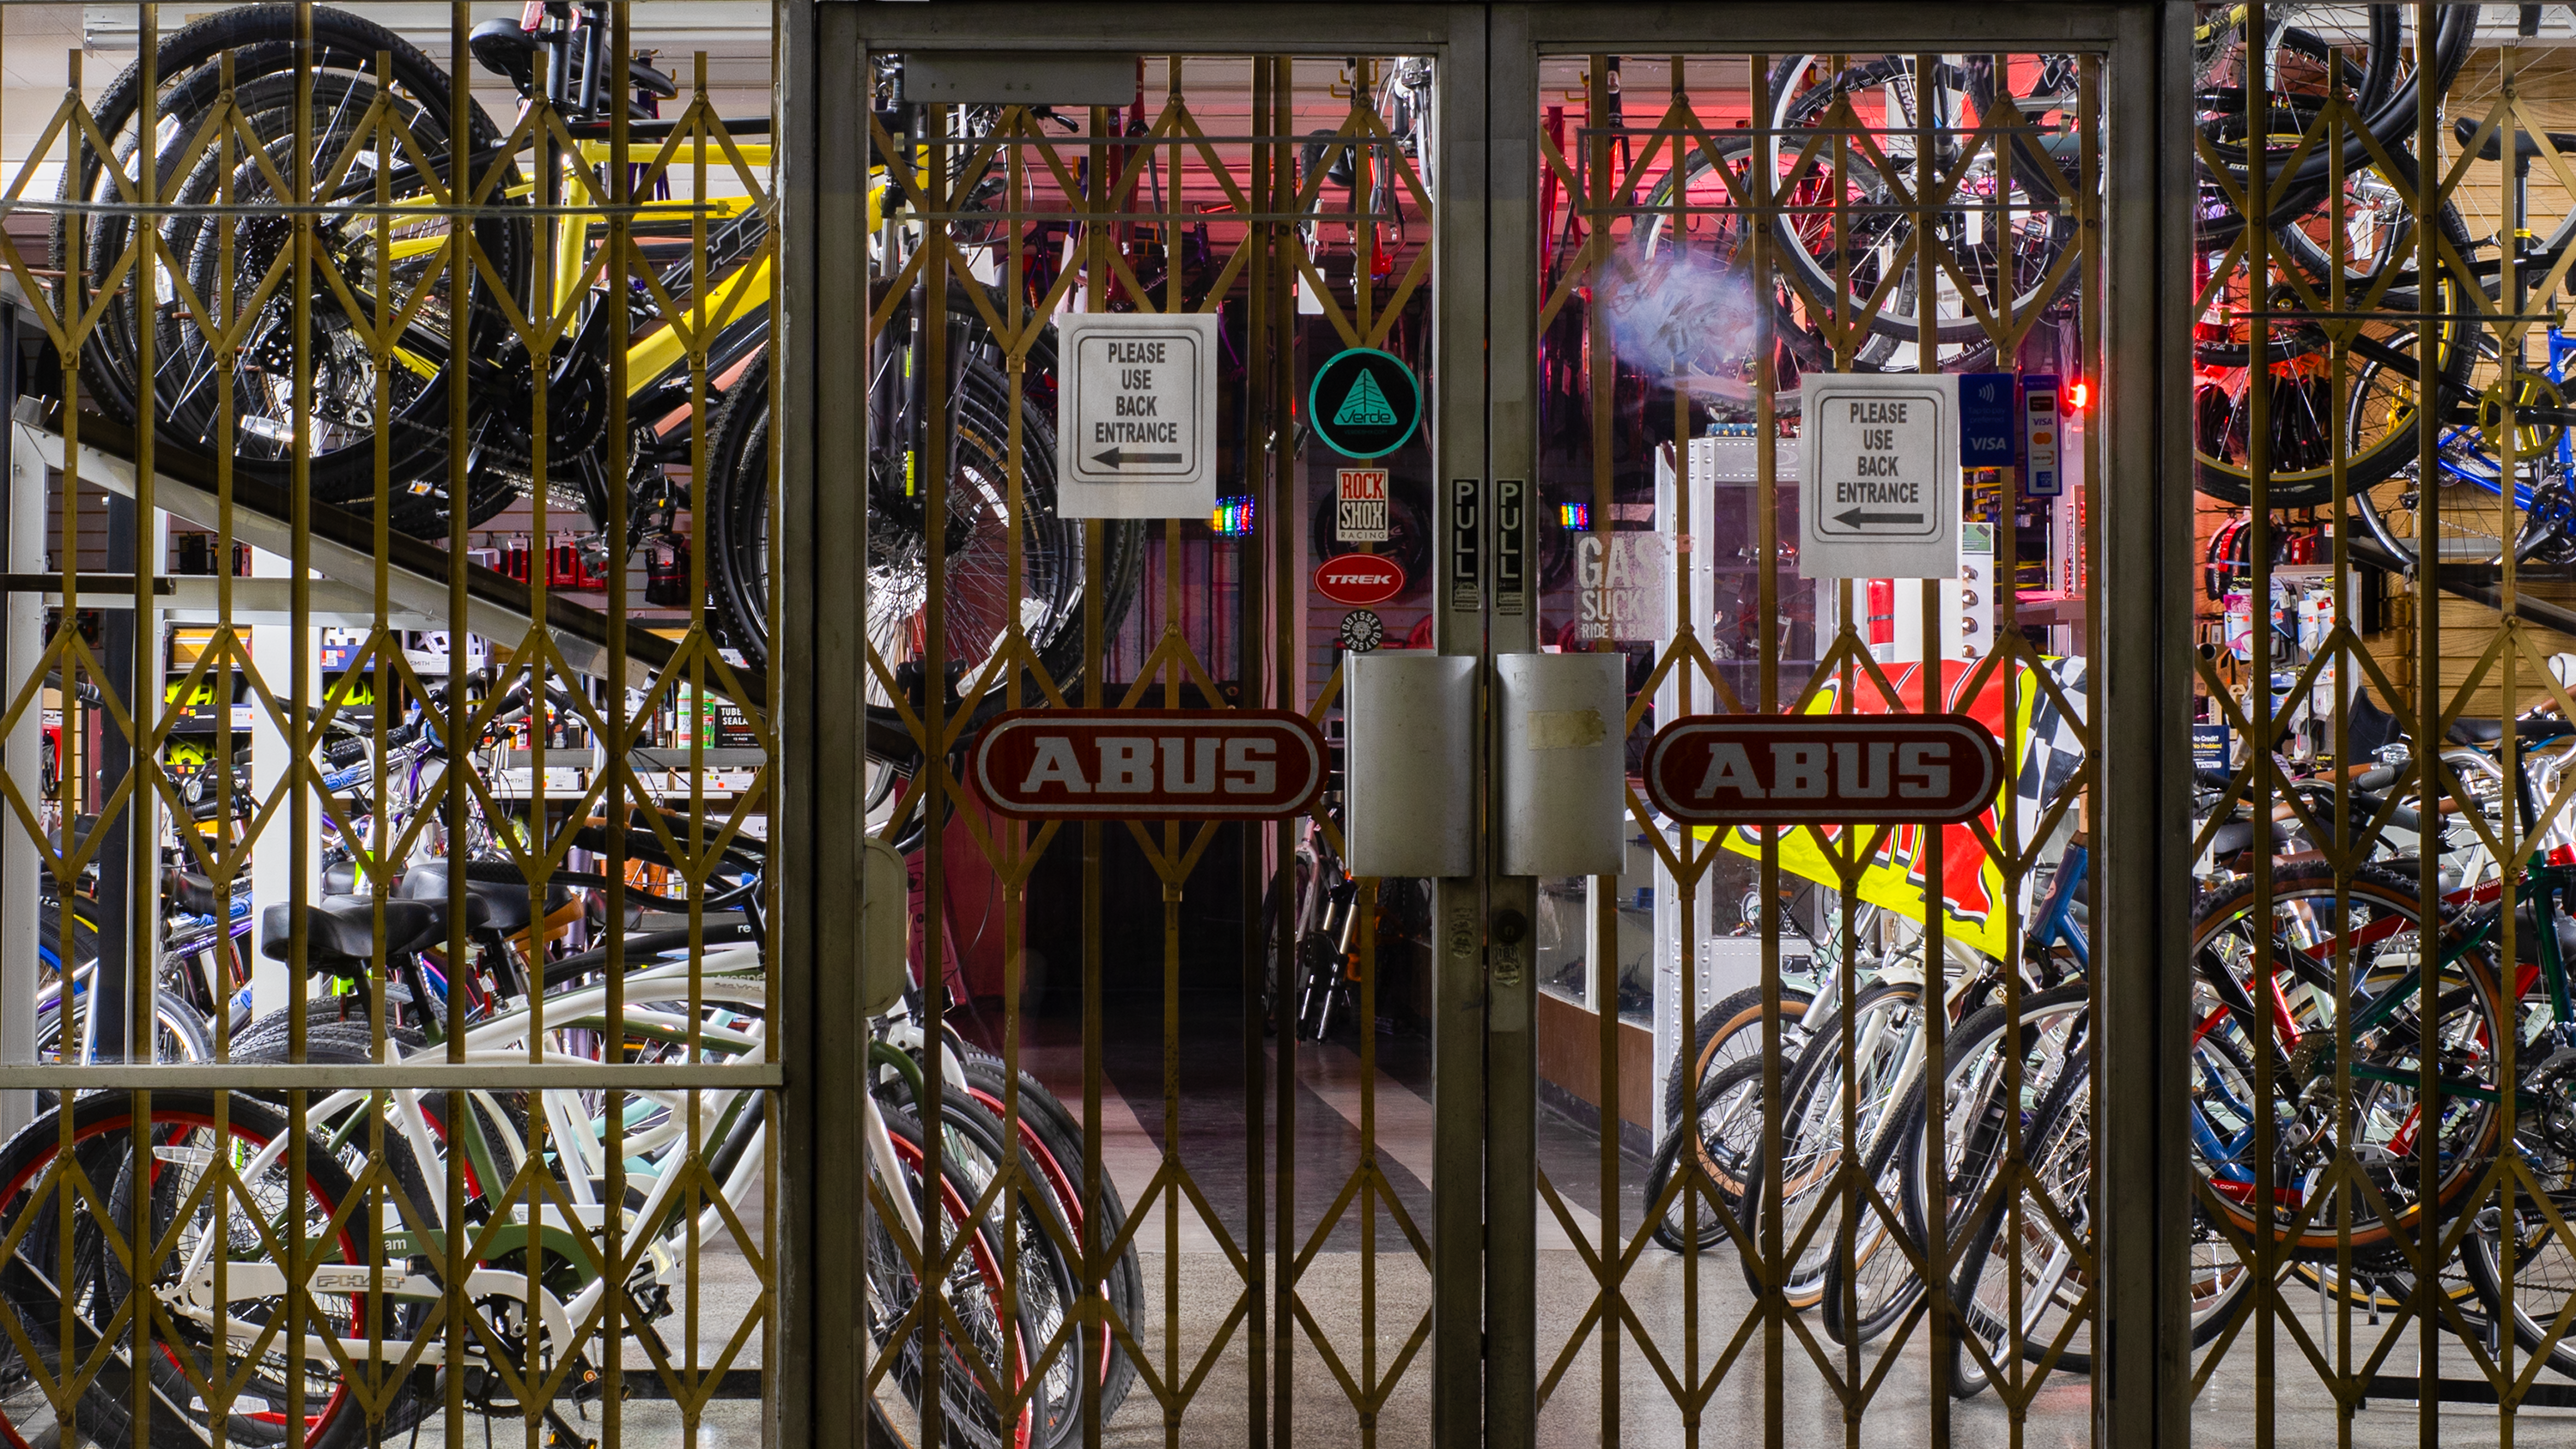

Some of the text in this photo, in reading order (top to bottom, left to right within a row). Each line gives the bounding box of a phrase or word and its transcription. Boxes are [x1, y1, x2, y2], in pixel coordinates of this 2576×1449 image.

[1108, 343, 1165, 363] PLEASE
[1121, 369, 1151, 390] USE
[1116, 396, 1157, 416] BACK
[1340, 409, 1391, 423] Verde
[1850, 403, 1907, 423] PLEASE
[1096, 422, 1177, 443] ENTRANCE
[2032, 418, 2053, 427] VISA
[1863, 429, 1893, 450] USE
[1969, 437, 2007, 451] VISA
[1857, 456, 1899, 476] BACK
[1341, 473, 1384, 500] ROCK
[1837, 482, 1918, 503] ENTRANCE
[1341, 501, 1384, 529] SHOX
[1340, 531, 1386, 540] RACING
[1456, 482, 1474, 577] PULL
[1501, 482, 1519, 578] PULL
[1578, 537, 1660, 589] GAS
[1326, 574, 1393, 585] TREK
[1581, 623, 1609, 639] RIDE
[1614, 623, 1624, 638] A
[722, 717, 749, 725] SEALA
[1019, 737, 1277, 794] ABUS
[1694, 743, 1952, 799] ABUS
